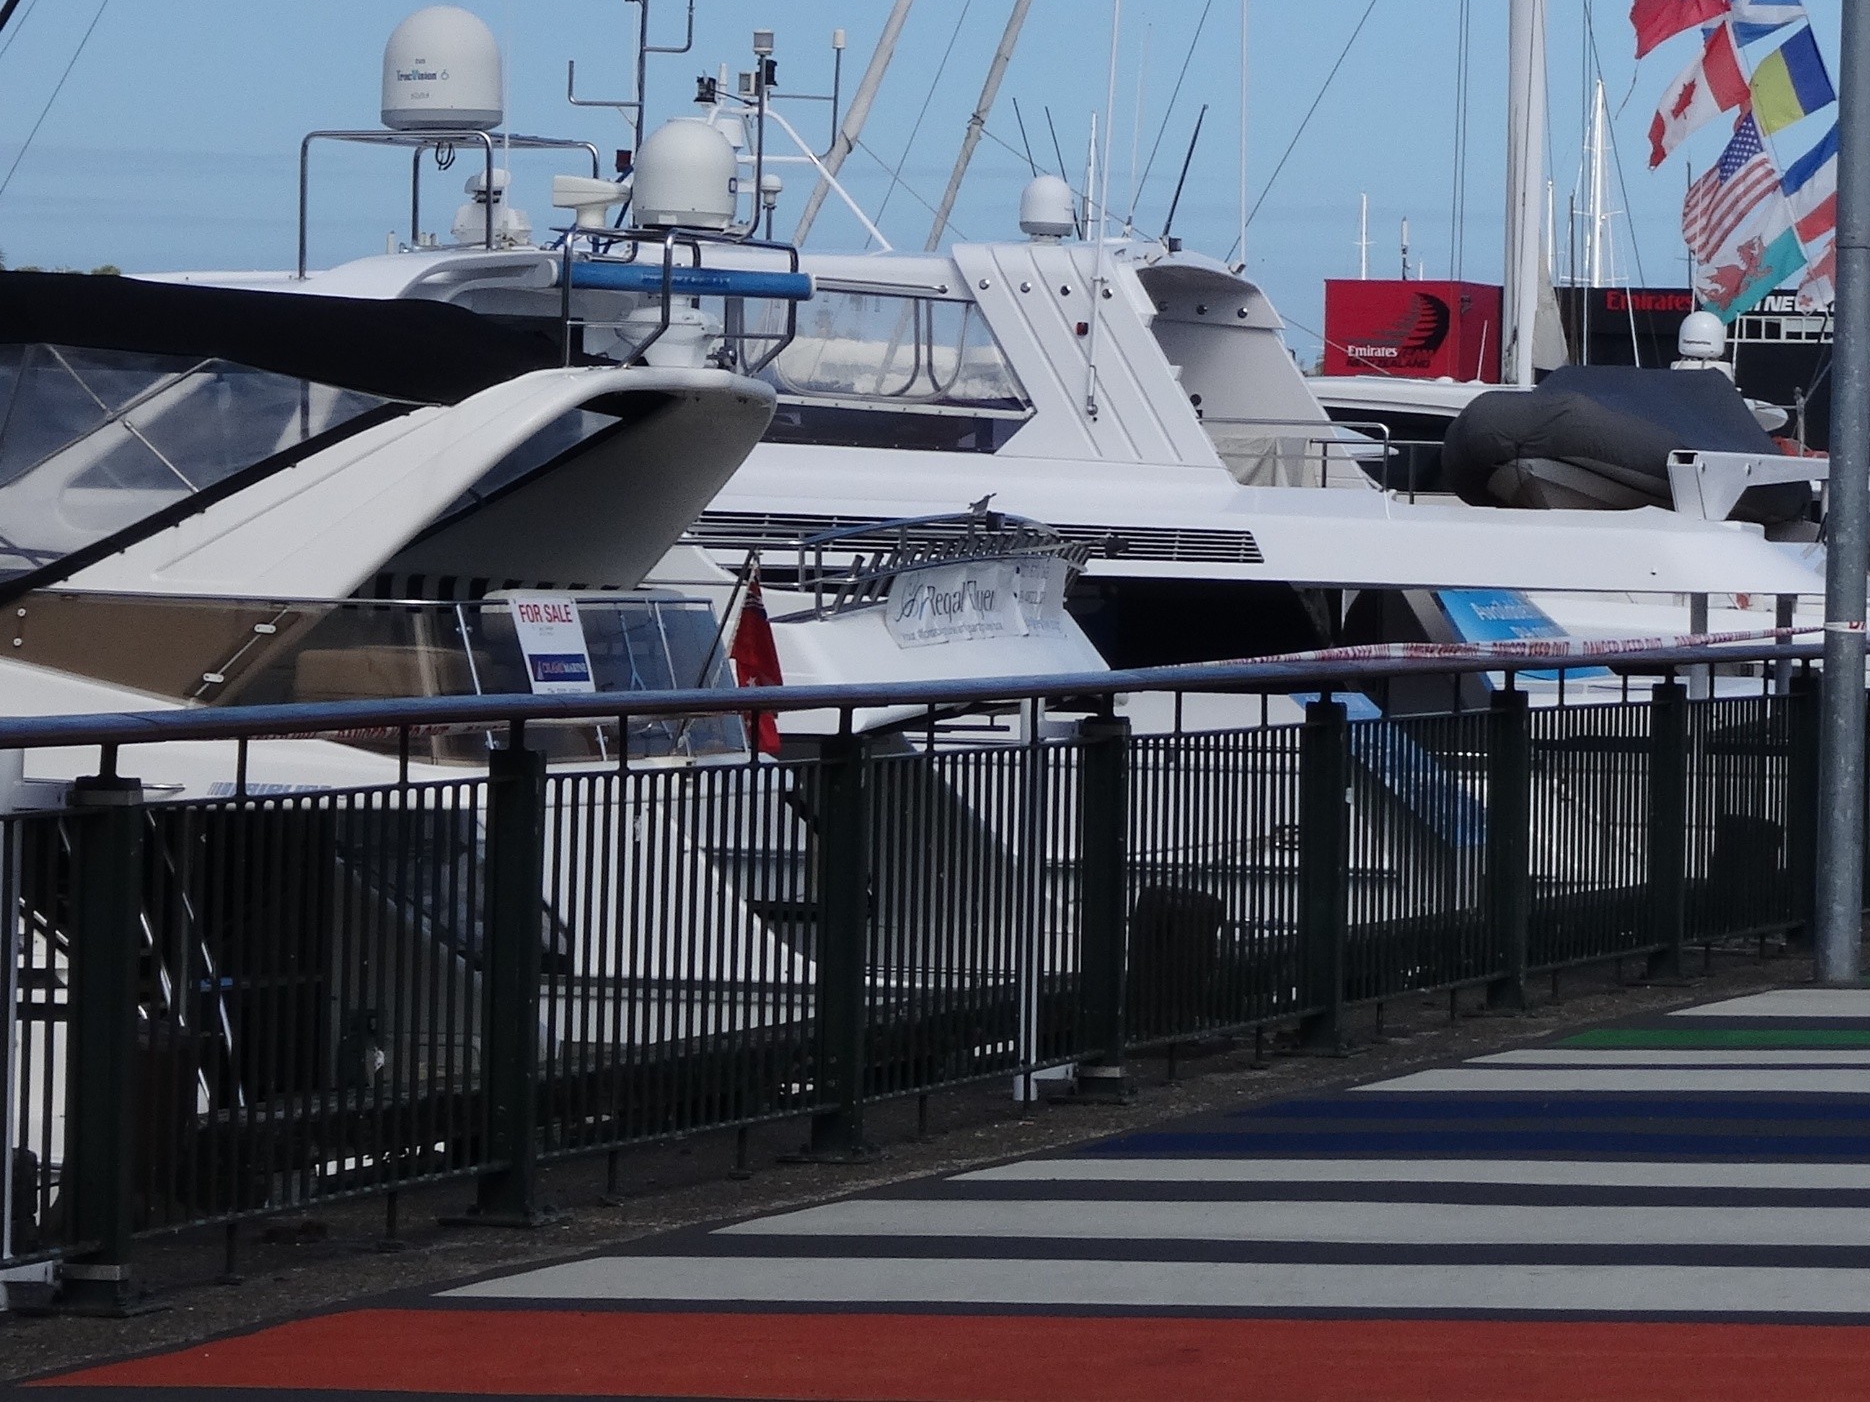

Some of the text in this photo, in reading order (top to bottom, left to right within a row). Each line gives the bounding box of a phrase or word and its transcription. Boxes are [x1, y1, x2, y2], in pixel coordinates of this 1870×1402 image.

[1347, 344, 1398, 358] Emirates
[518, 604, 573, 623] FOR SALE
[1583, 639, 1619, 655] DANGER
